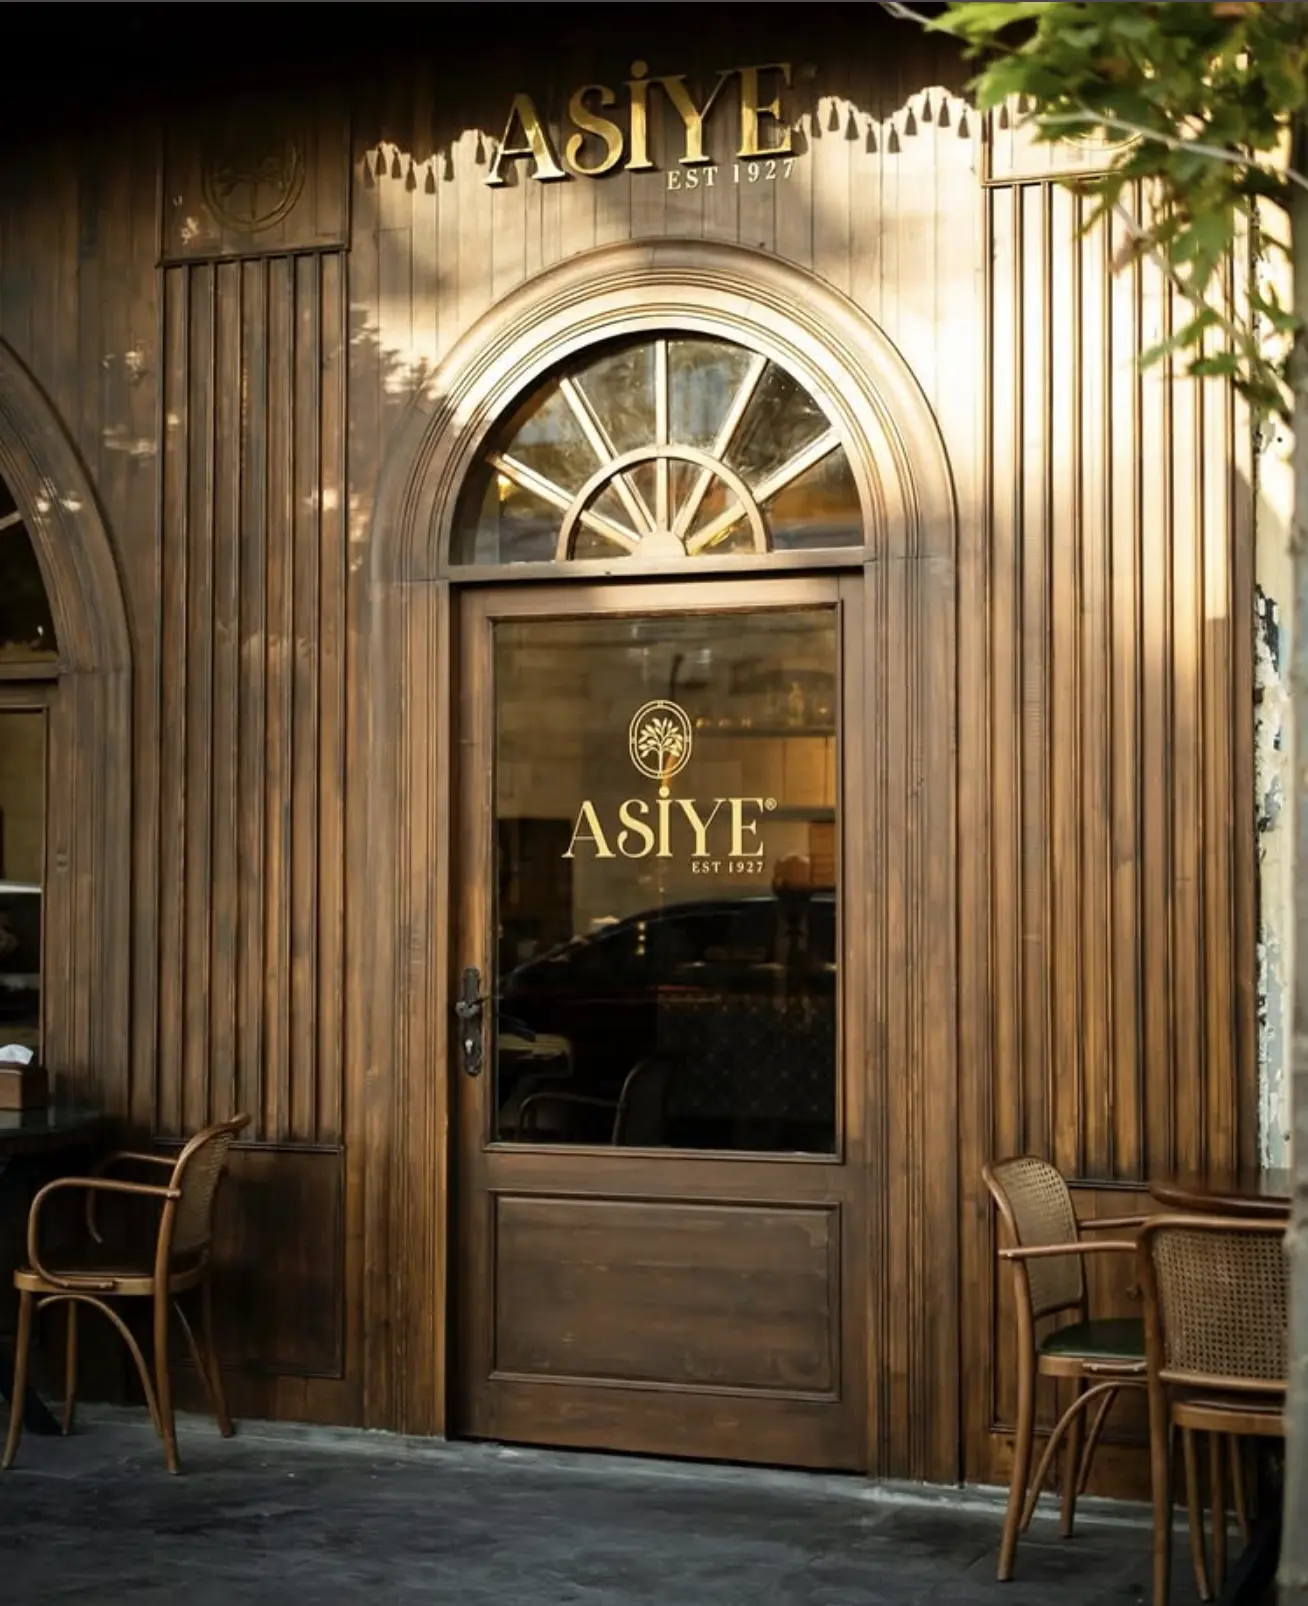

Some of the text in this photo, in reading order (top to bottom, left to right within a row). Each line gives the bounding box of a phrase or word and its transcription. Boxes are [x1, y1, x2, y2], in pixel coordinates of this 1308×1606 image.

[485, 60, 792, 185] ASİYE
[667, 159, 795, 190] EST 1927
[692, 861, 764, 873] EST 1927
